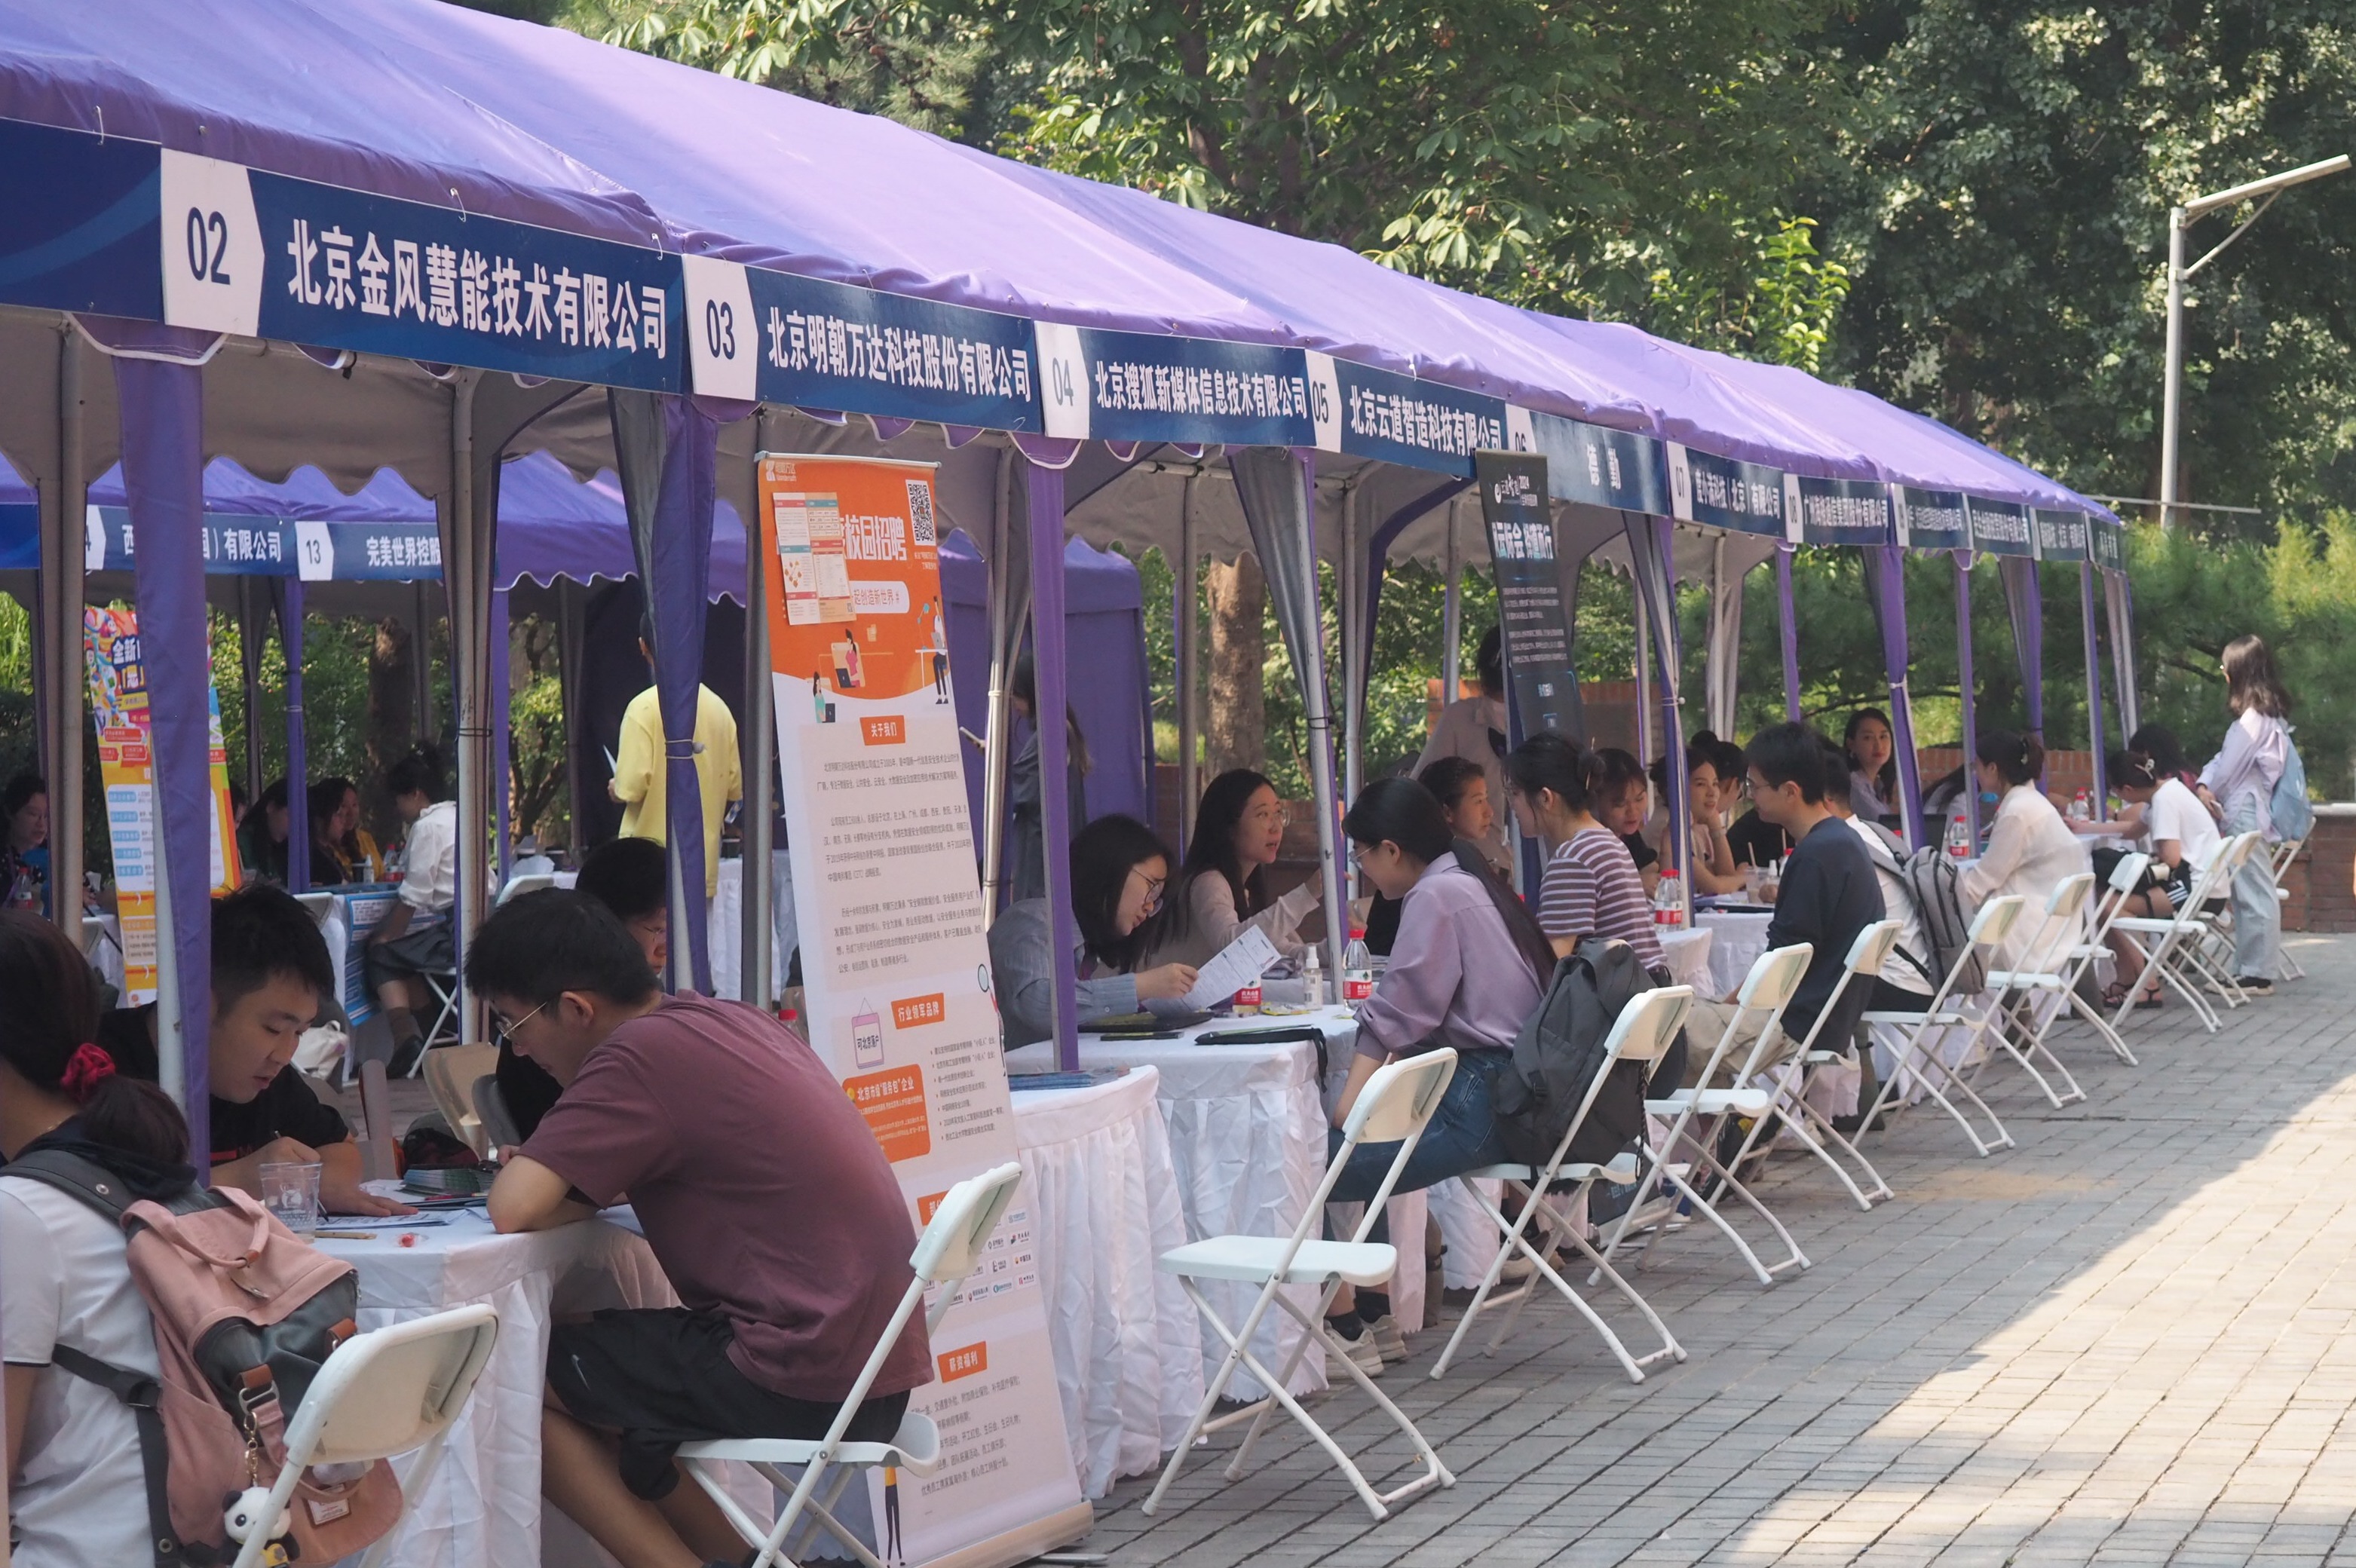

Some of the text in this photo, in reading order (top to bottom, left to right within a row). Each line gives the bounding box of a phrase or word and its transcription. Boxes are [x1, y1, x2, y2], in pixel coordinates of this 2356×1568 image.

[185, 207, 231, 285] 02
[286, 217, 667, 359] 北京金风慧能技术有限公司
[706, 299, 735, 360] 03
[766, 305, 1032, 403] 北京明朝万达科技股份有限公司
[1052, 356, 1075, 408] 04
[1095, 360, 1308, 420] 北京搜狐新媒体信息技术有限公司
[1312, 380, 1329, 424] 05
[1349, 384, 1502, 457] 北京云道智造科技有限公司
[1586, 443, 1622, 490] 德勤
[1675, 466, 1686, 498] 07
[305, 538, 322, 565] 13
[871, 721, 898, 737] 关于我们
[898, 1000, 940, 1022] 行业领军品牌
[948, 1352, 979, 1373] 薪资福利
